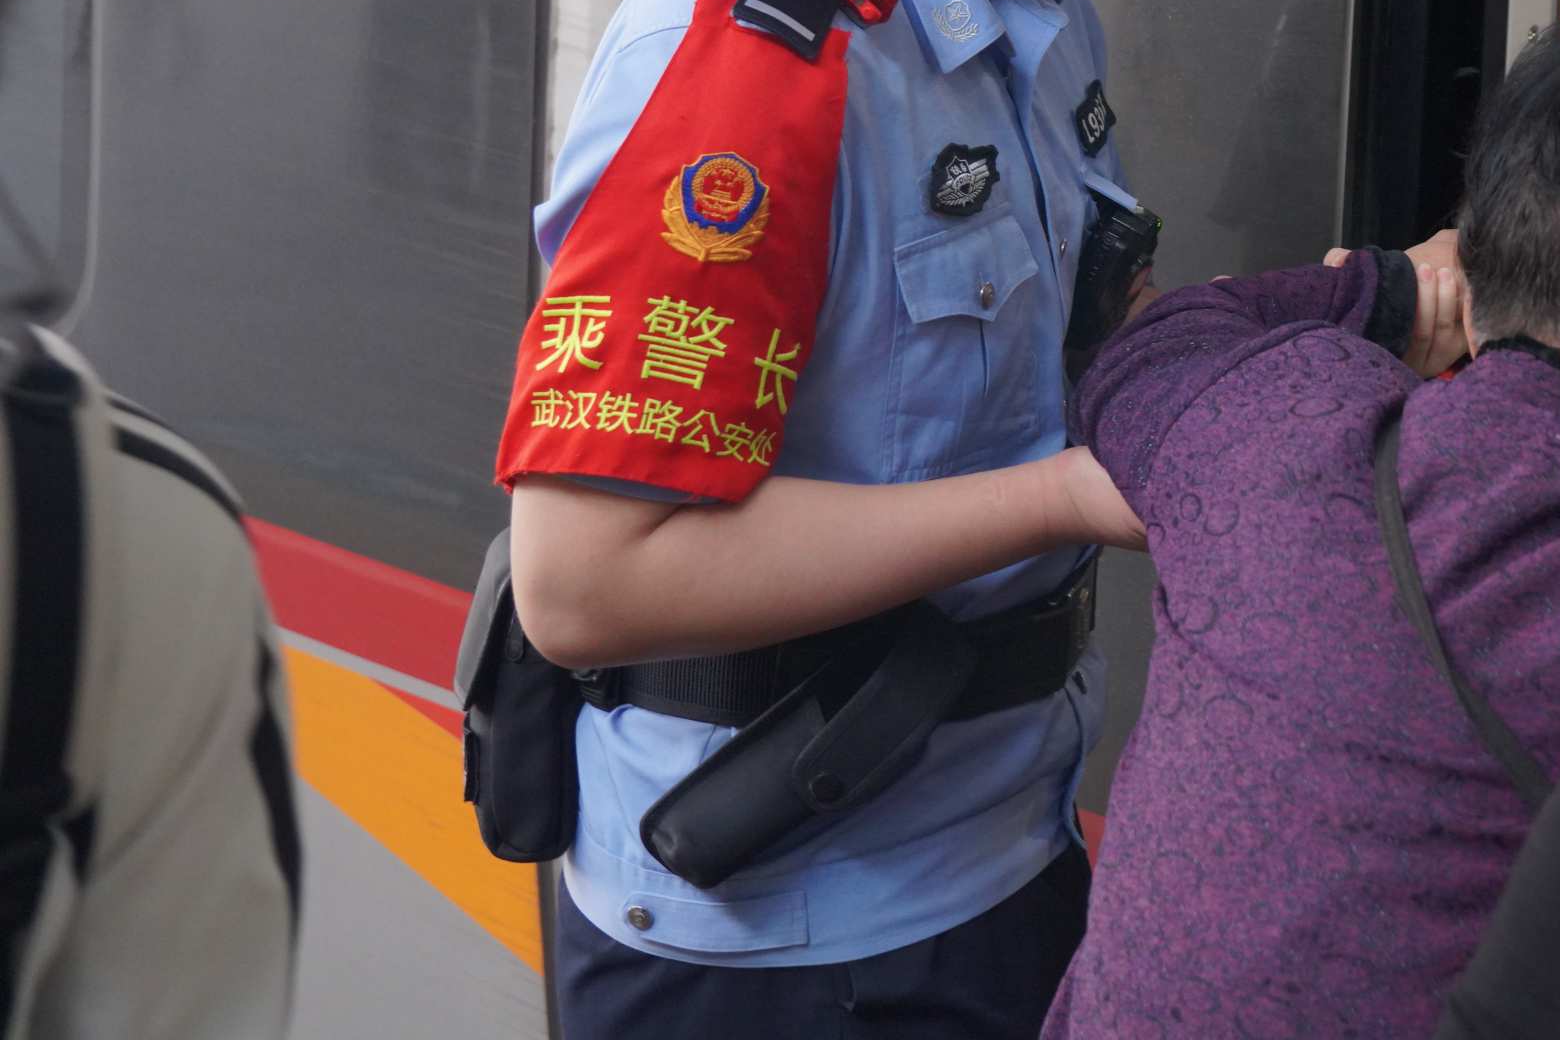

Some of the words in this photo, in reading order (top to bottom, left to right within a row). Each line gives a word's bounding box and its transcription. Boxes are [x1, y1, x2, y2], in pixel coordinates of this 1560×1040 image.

[530, 388, 777, 466] 武汉铁路公安处
